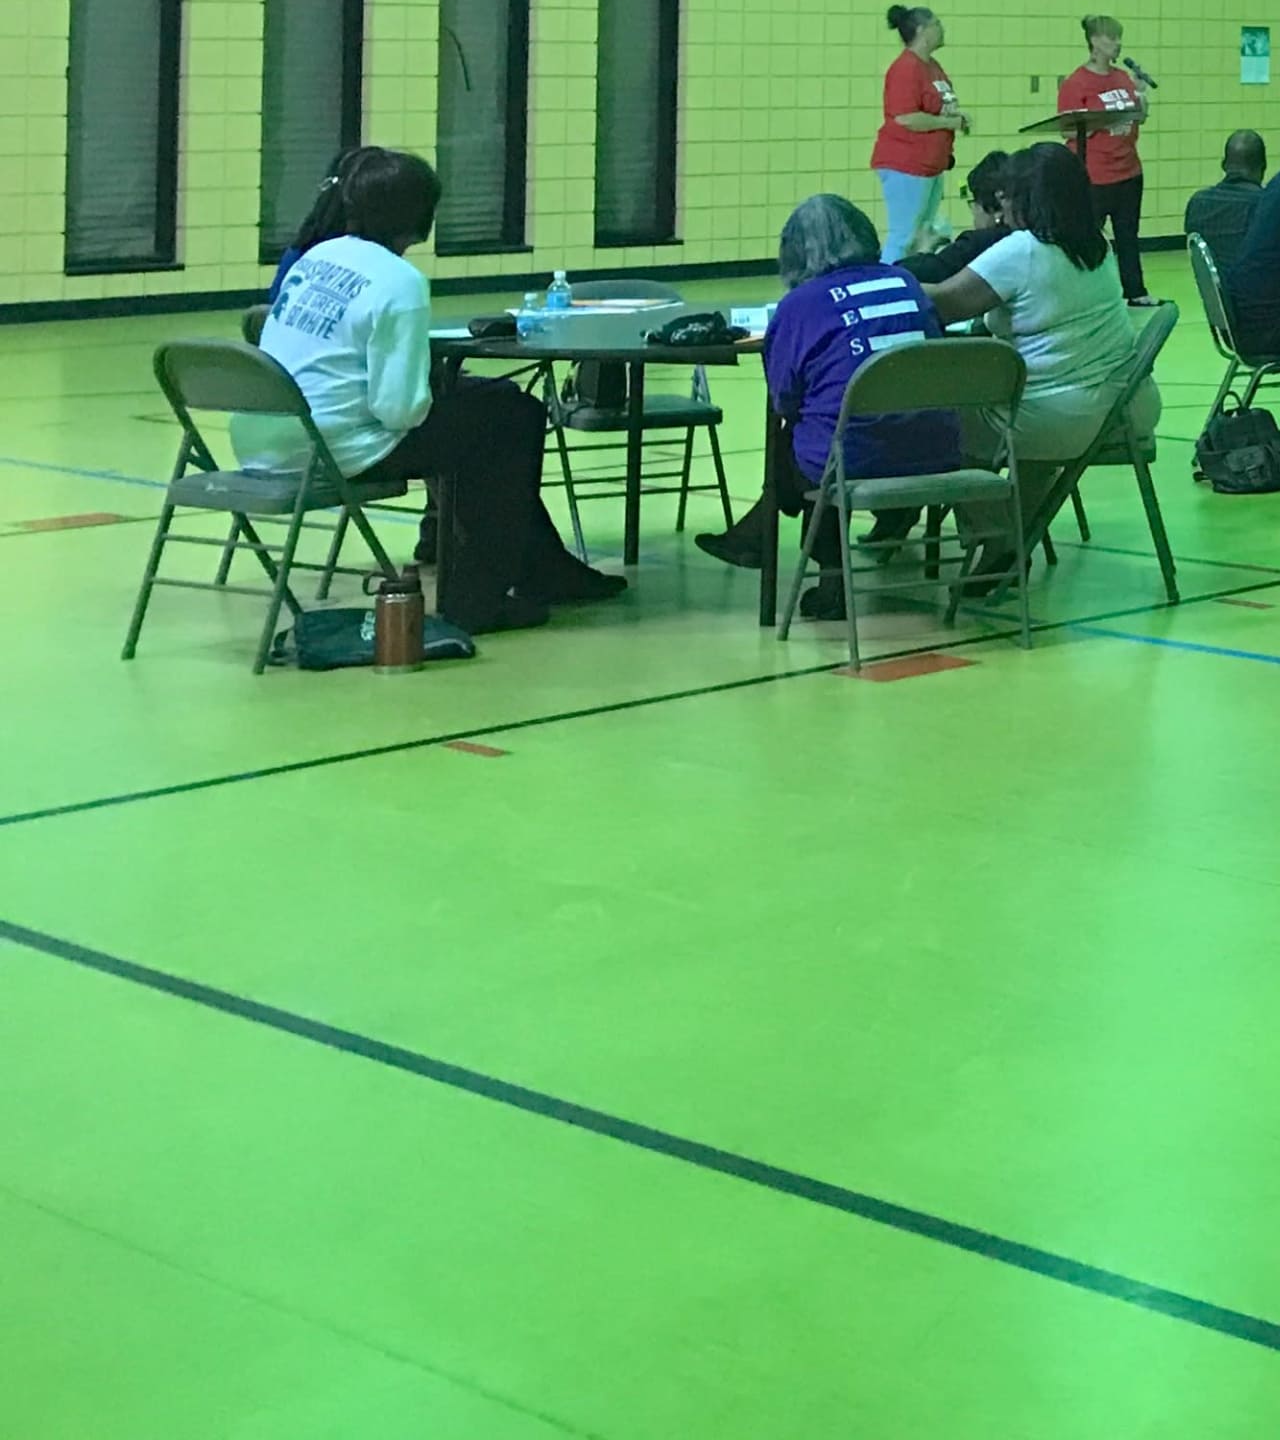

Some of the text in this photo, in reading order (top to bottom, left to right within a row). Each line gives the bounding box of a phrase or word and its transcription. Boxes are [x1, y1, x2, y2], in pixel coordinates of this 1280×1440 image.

[305, 259, 372, 299] SPARTANS
[828, 287, 847, 303] B
[296, 310, 338, 339] WHITE
[841, 310, 859, 327] E
[850, 337, 864, 356] S
